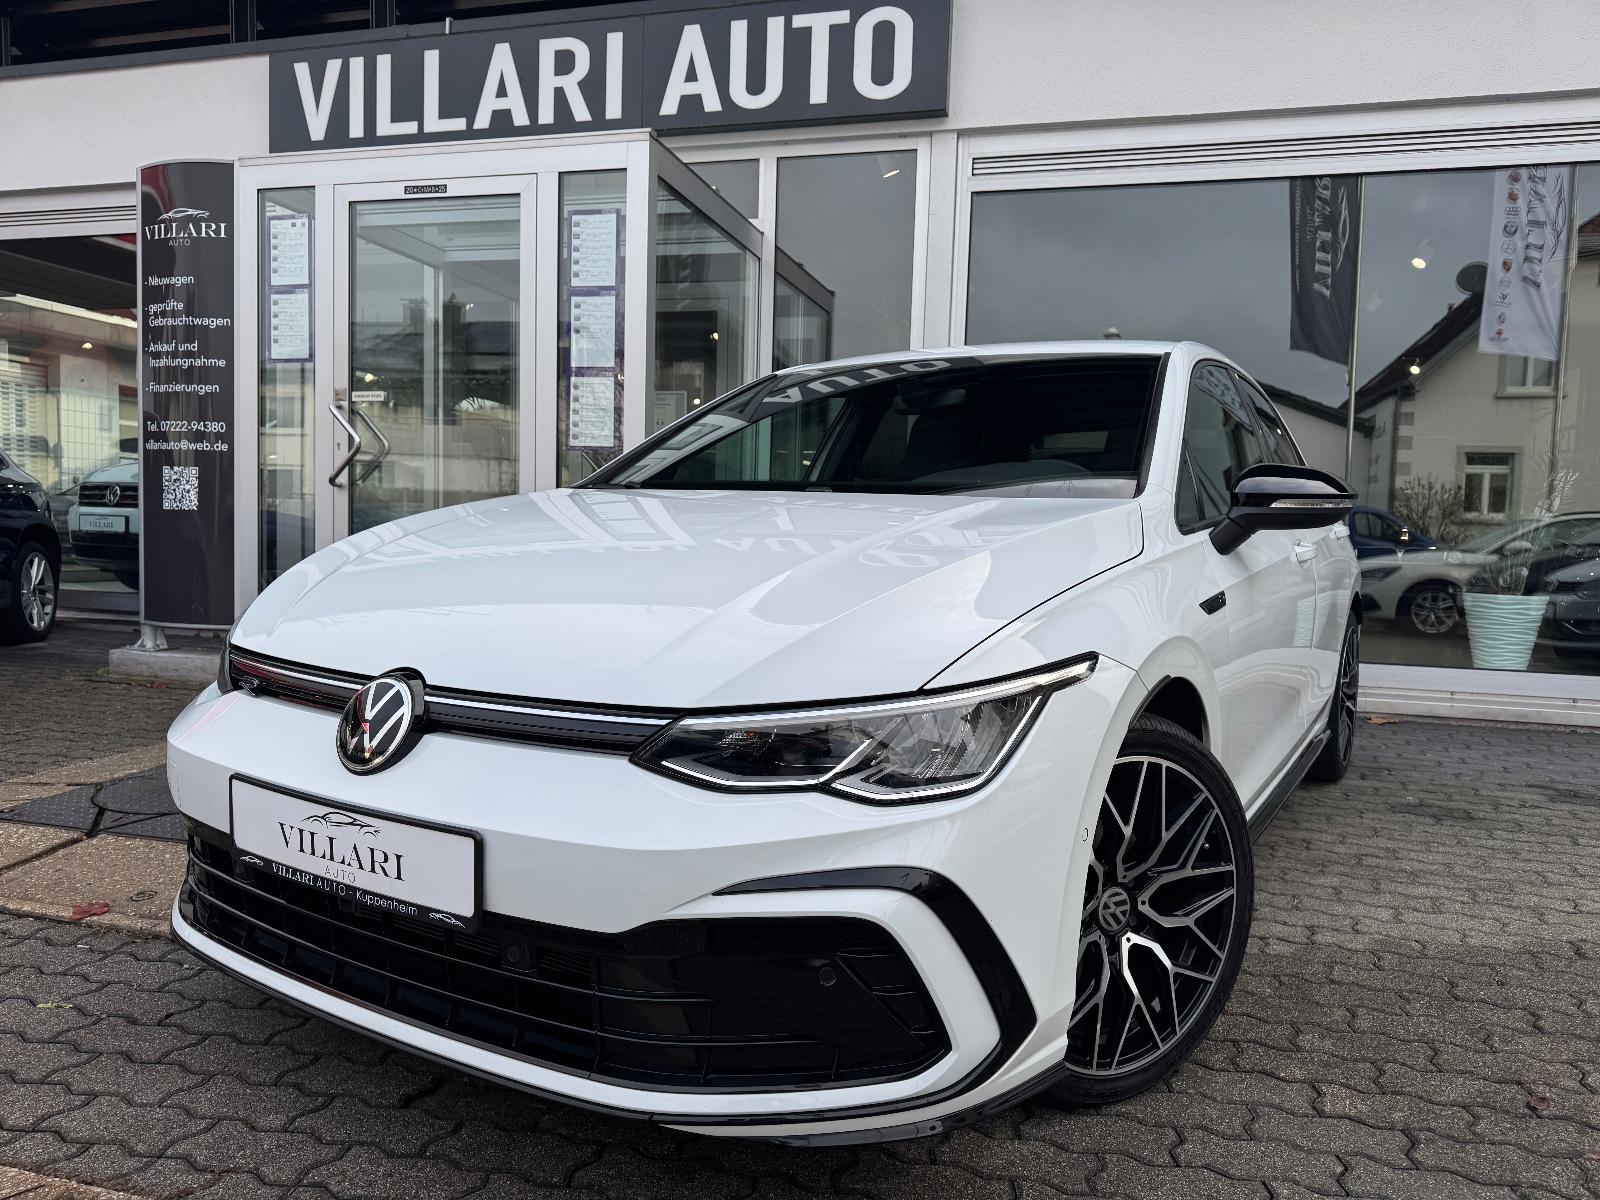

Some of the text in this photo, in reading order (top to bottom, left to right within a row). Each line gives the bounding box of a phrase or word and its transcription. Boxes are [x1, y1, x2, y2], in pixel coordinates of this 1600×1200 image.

[293, 6, 914, 142] VILLARI AUTO
[144, 222, 228, 241] VILLARI
[168, 239, 191, 247] AUTO
[148, 275, 194, 287] Neuwagen
[148, 299, 184, 315] geprüfte
[149, 314, 231, 328] Gebrauchtwagen
[149, 340, 176, 352] Ankauf
[178, 340, 198, 351] und
[149, 355, 226, 369] Inzahlungnahme
[149, 382, 220, 395] Finanzierungen
[147, 421, 226, 433] Tel. 07222-94380
[145, 439, 229, 451] villariauto@web.de
[277, 821, 406, 882] VILLARI
[324, 865, 356, 884] AUTO
[272, 862, 314, 886] VILLARI
[316, 879, 346, 896] AUTO
[356, 890, 418, 916] Kuppenheim
